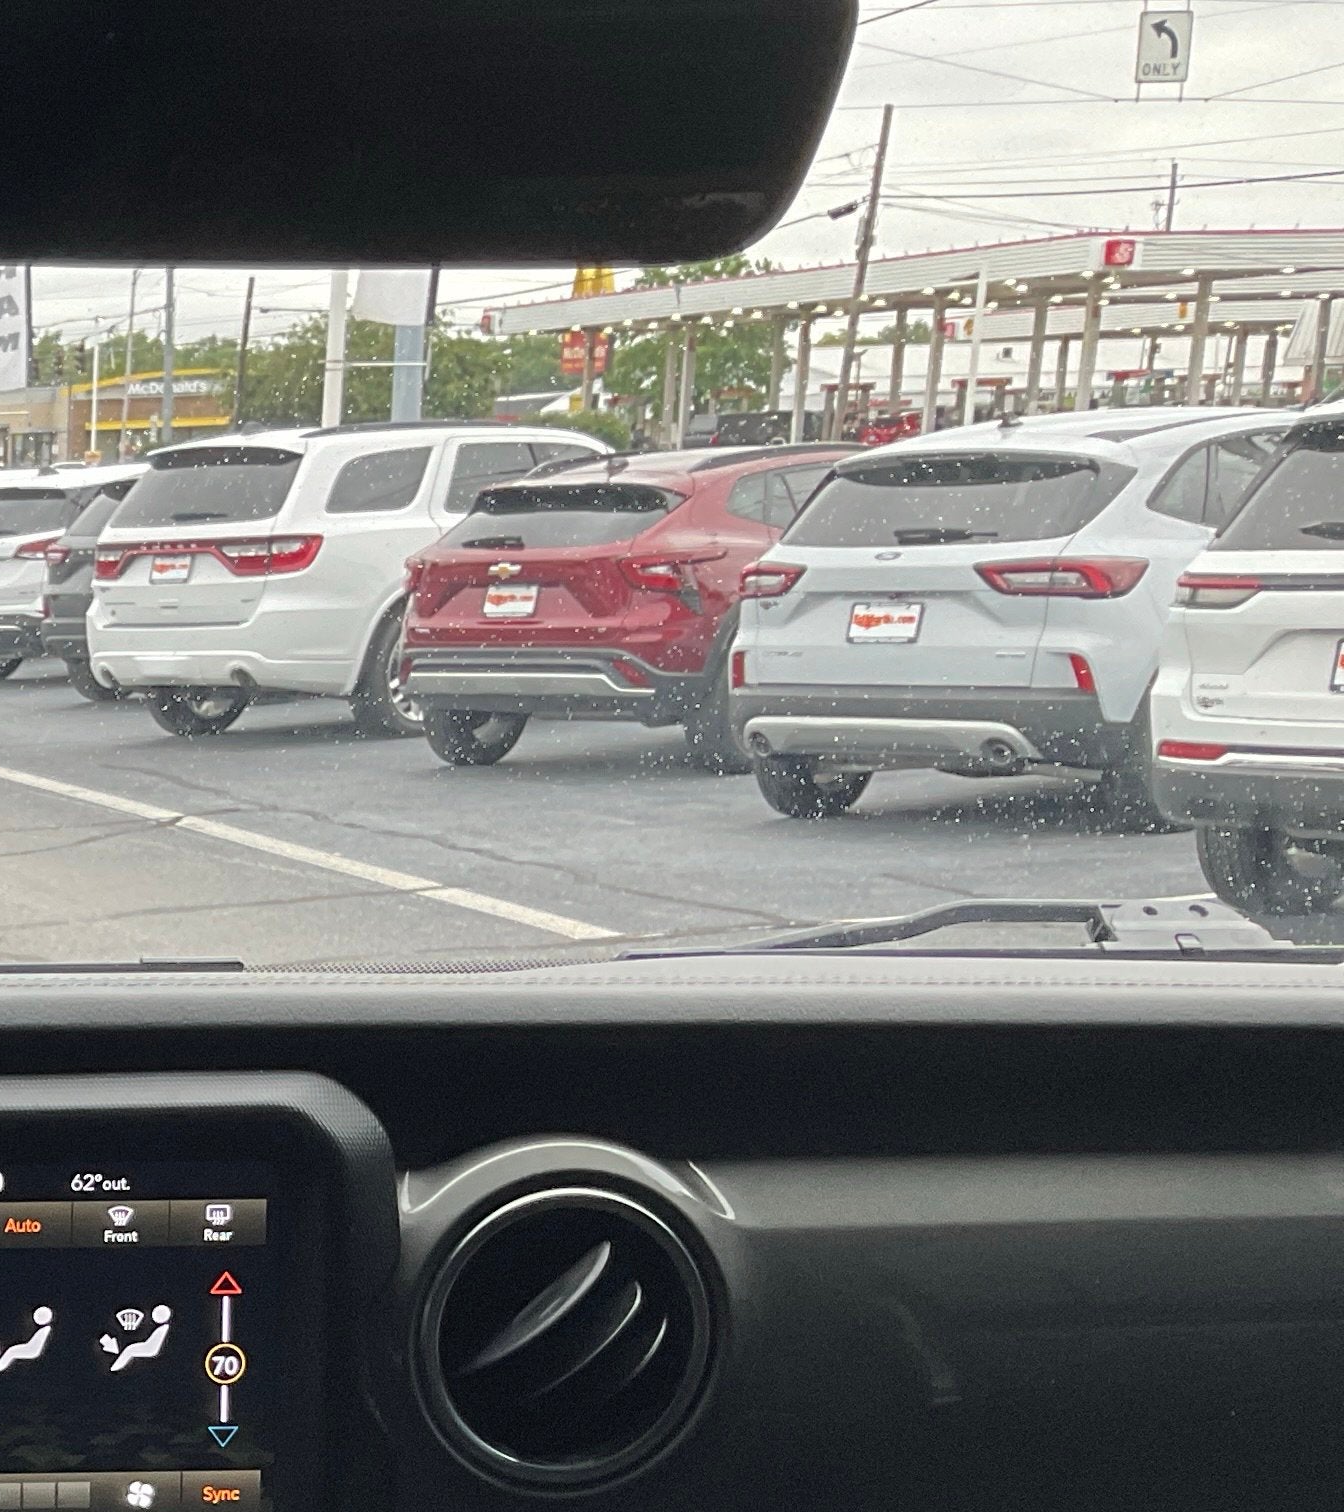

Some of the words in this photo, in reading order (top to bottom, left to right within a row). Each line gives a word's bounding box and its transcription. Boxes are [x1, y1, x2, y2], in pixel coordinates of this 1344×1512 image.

[1142, 62, 1180, 76] ONLY
[4, 1218, 41, 1233] Auto
[103, 1230, 139, 1243] Front
[203, 1229, 233, 1242] Rear
[212, 1355, 239, 1375] 70
[202, 1486, 240, 1504] Sync
